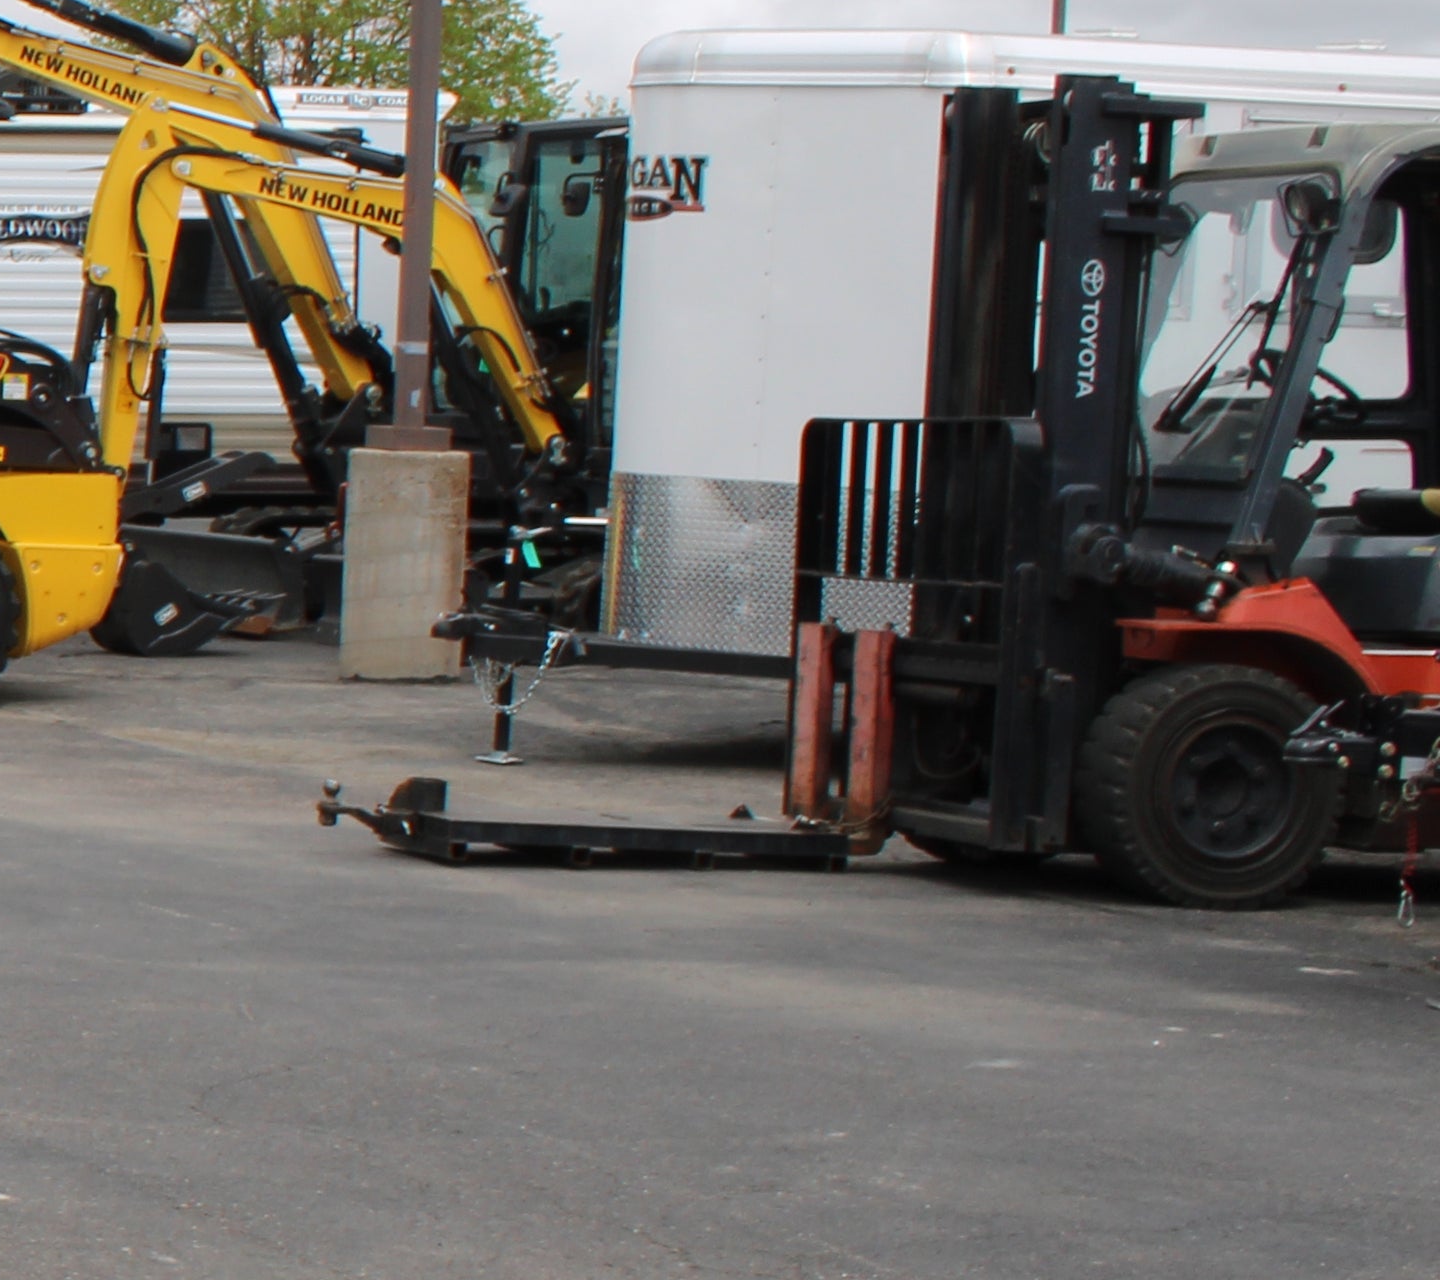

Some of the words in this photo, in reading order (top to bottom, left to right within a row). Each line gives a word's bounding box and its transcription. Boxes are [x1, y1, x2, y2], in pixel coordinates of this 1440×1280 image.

[20, 45, 63, 74] NEW
[302, 94, 345, 104] LOGAN
[259, 177, 308, 202] NEW
[631, 157, 709, 204] GAN
[1075, 300, 1102, 399] TOYOTA
